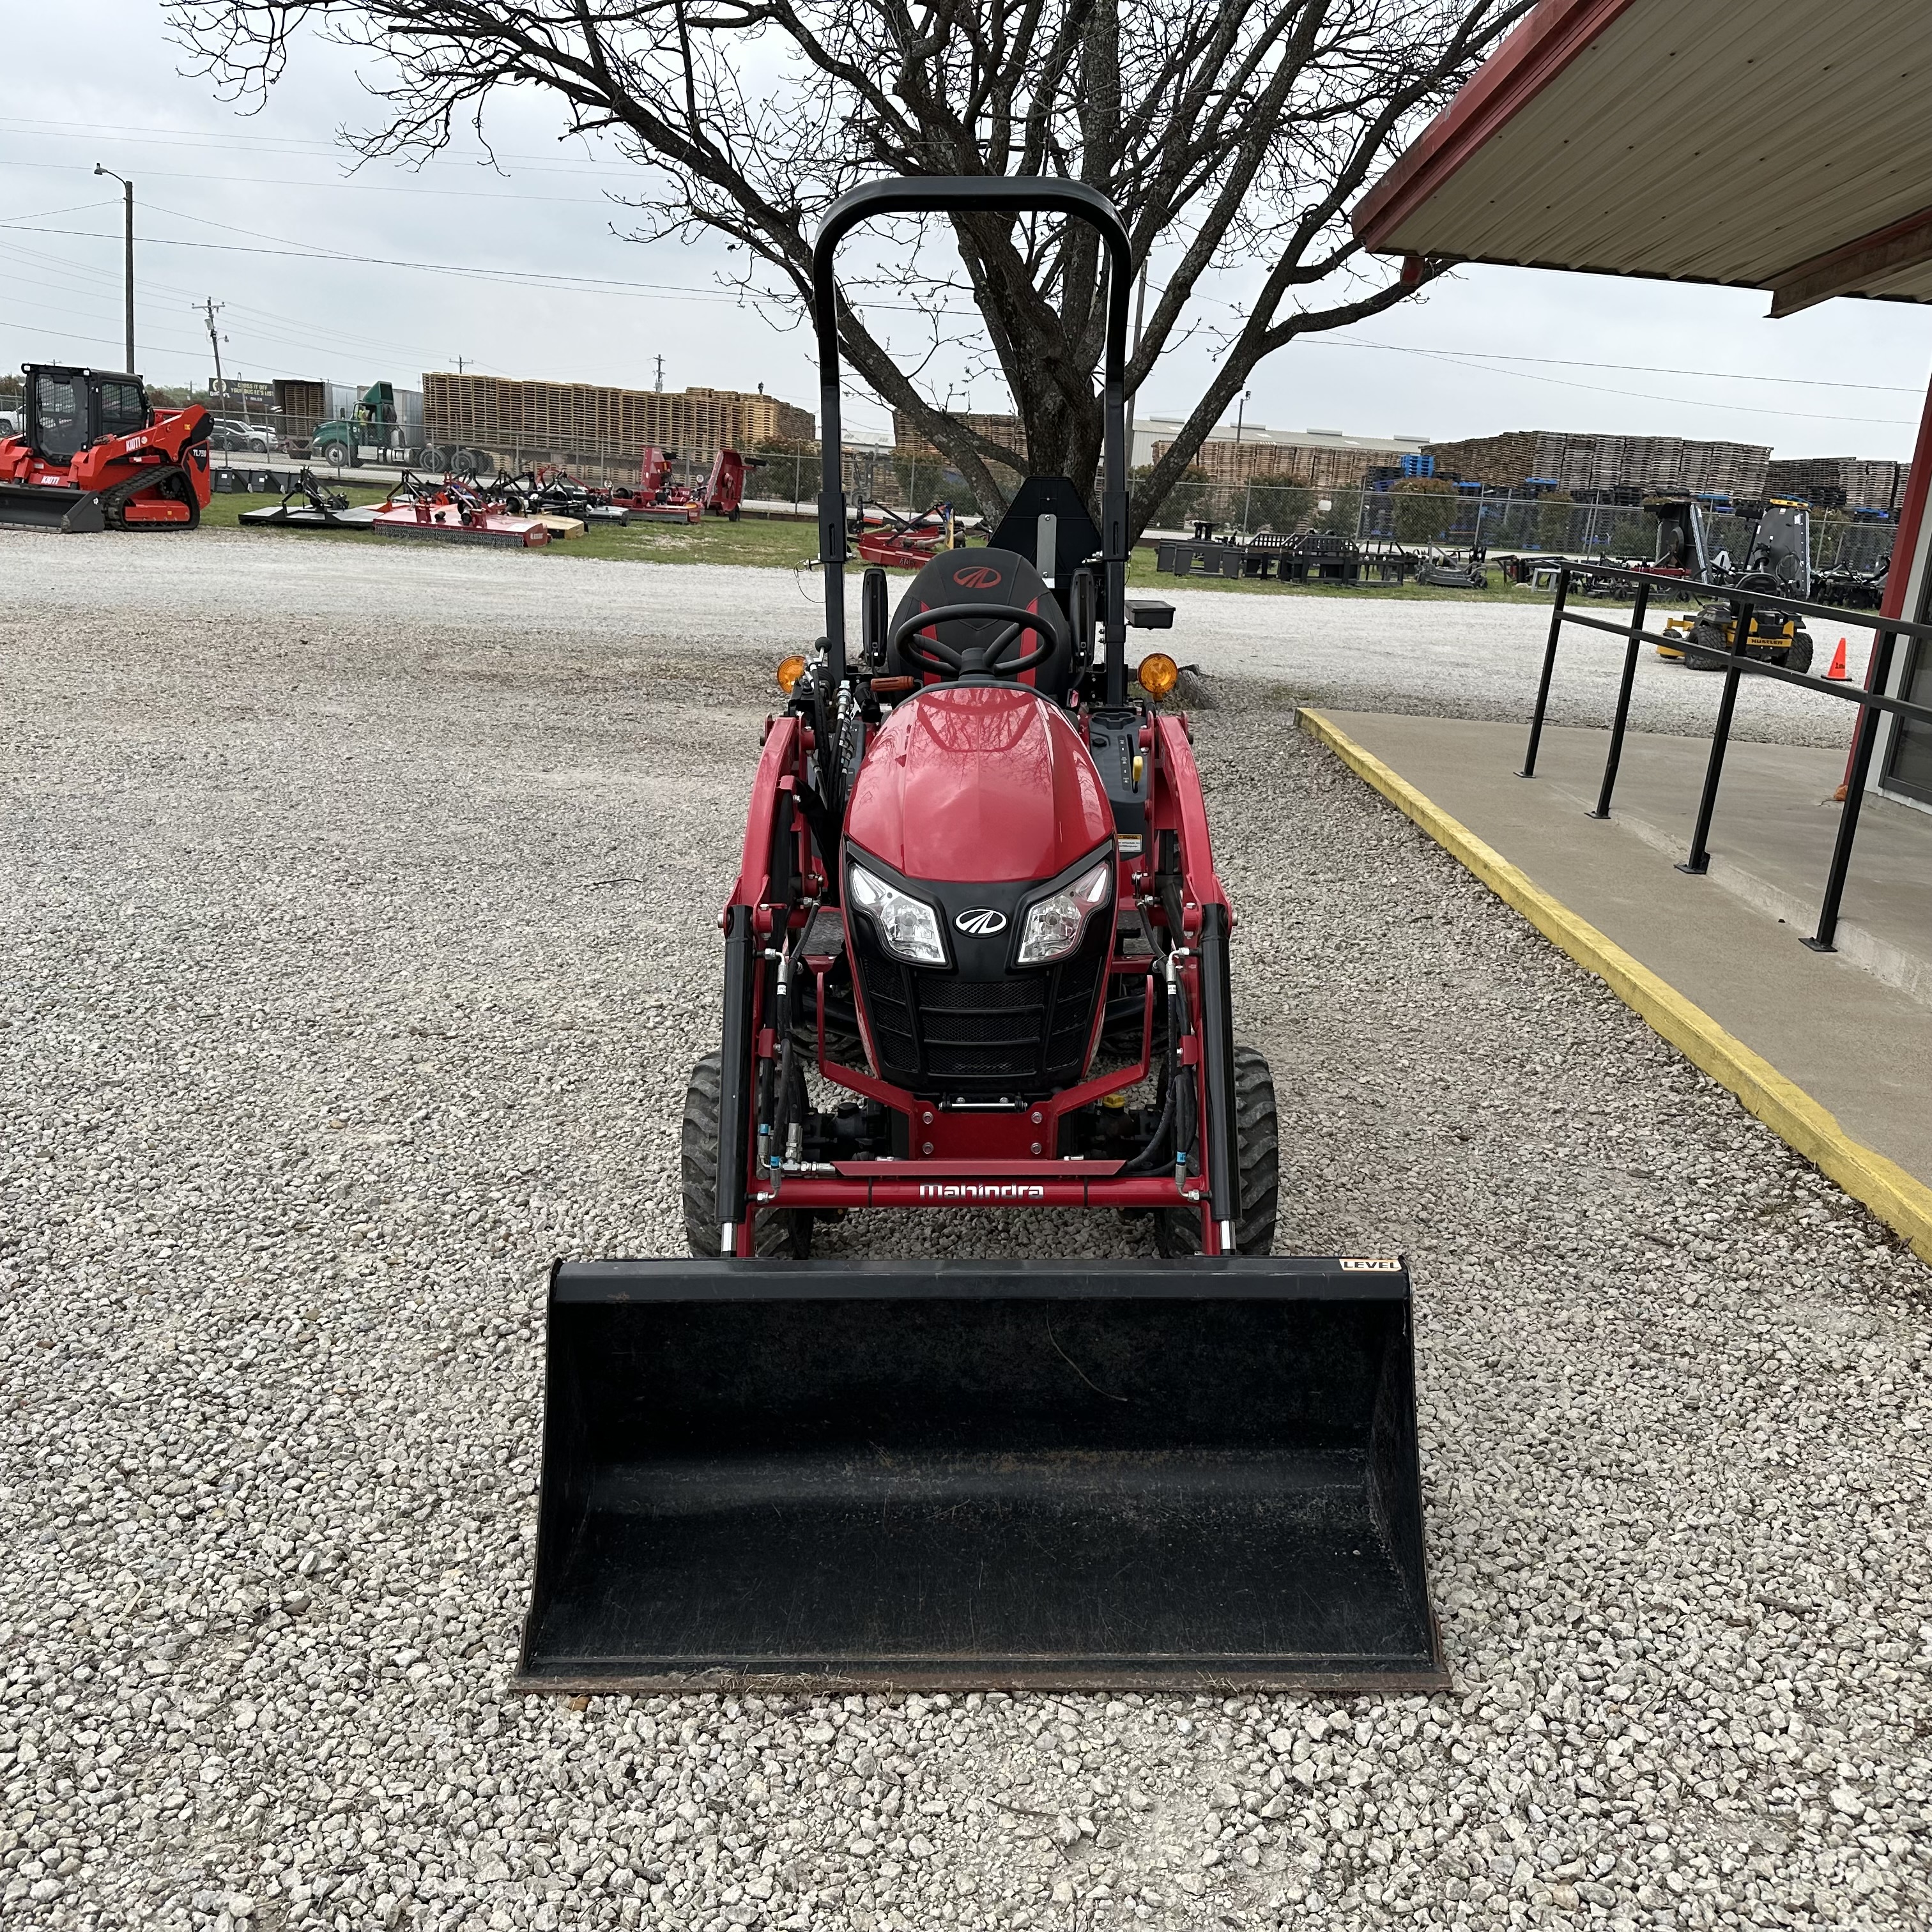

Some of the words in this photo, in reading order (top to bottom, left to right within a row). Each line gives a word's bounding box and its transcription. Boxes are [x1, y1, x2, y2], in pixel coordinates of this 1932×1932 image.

[126, 436, 141, 452] KIOTI
[41, 475, 60, 485] KIOTI
[919, 1182, 1044, 1199] Mahindra
